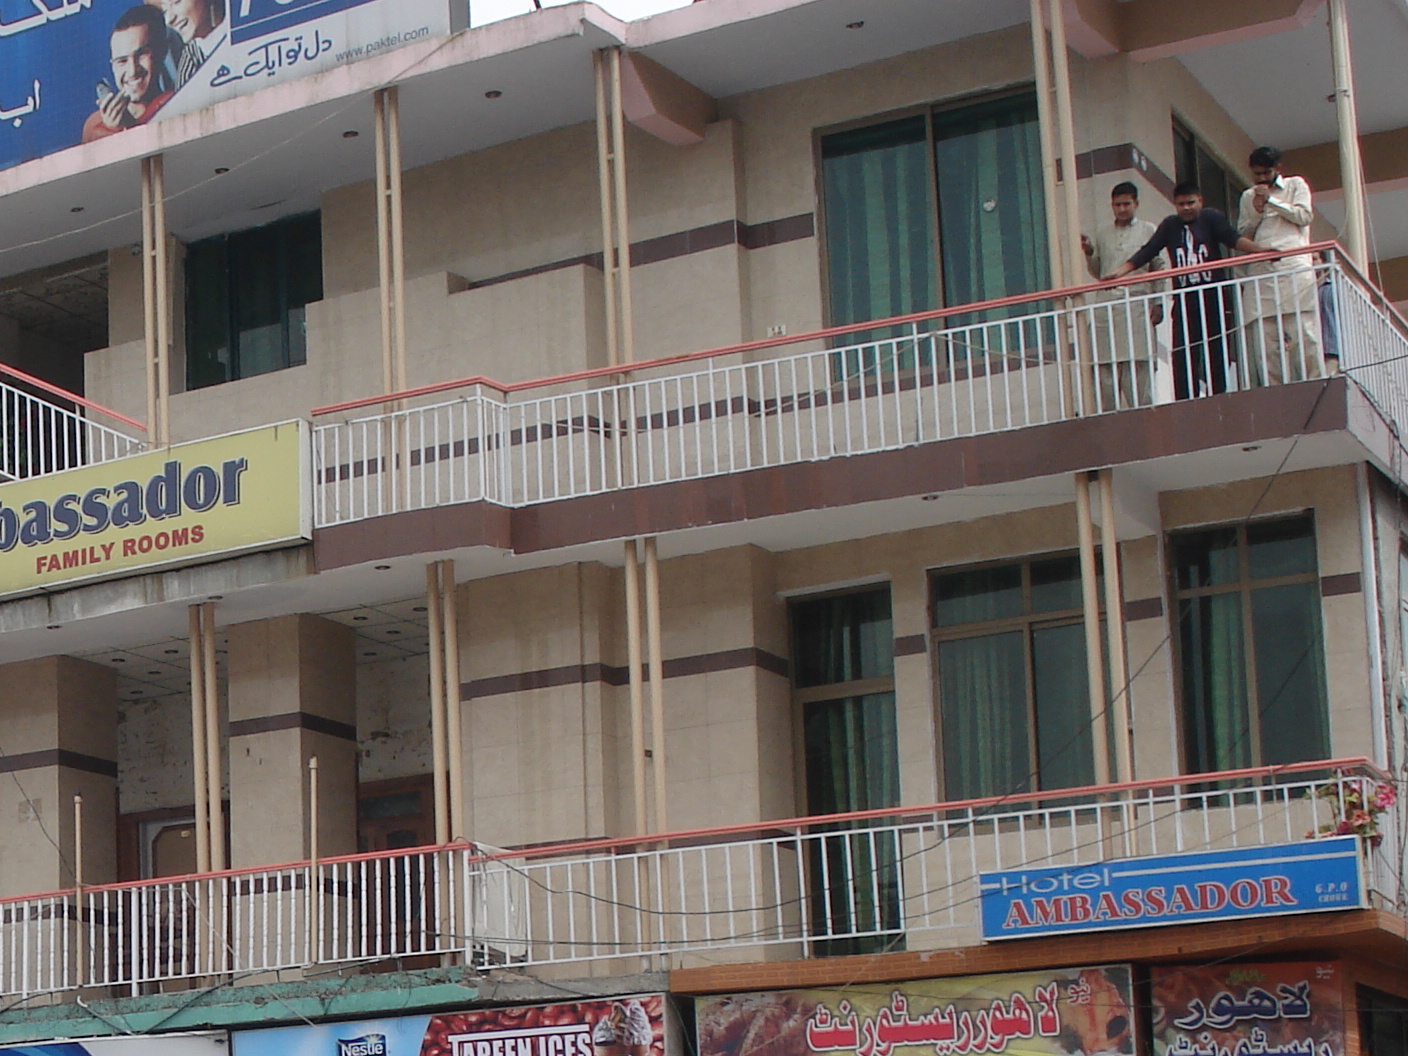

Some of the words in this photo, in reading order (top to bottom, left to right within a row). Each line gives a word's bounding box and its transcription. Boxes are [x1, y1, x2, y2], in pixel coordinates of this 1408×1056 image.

[335, 25, 430, 63] www.paktel.com
[35, 541, 117, 574] FAMILY
[122, 524, 205, 557] ROOMS
[1000, 868, 1110, 896] Hotel
[1002, 875, 1298, 929] AMBASSADOR
